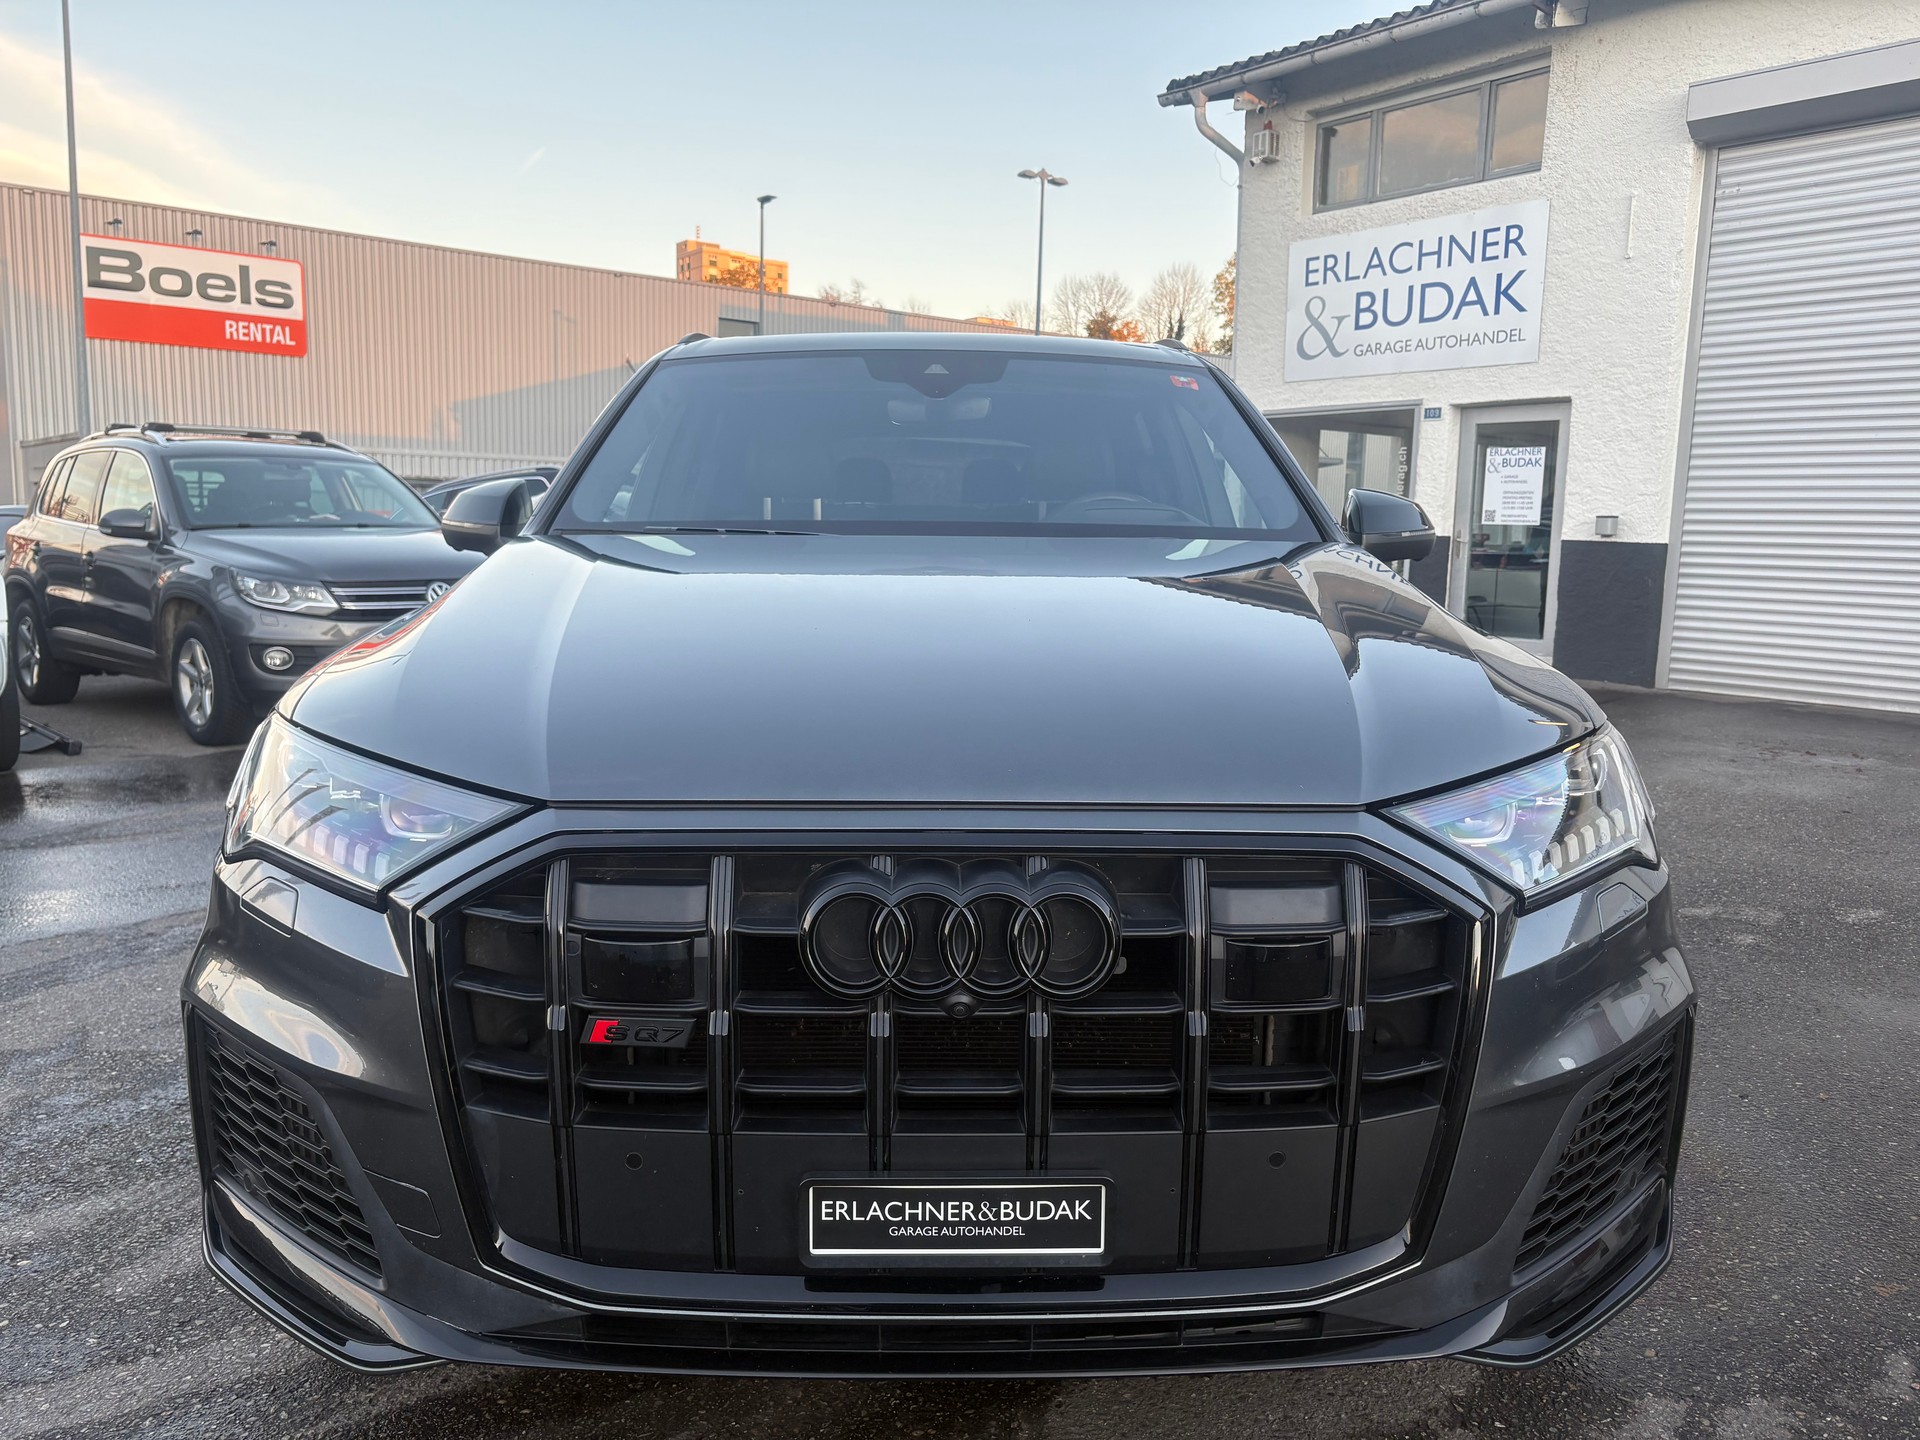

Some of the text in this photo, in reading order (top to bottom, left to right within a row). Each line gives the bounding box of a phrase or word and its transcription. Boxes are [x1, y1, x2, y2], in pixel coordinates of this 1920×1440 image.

[1304, 224, 1528, 287] ERLACHNER
[85, 245, 295, 309] Boels
[1296, 269, 1528, 360] & BUDAK
[225, 319, 296, 346] RENTAL
[1353, 328, 1526, 357] GARAGE AUTOHANDEL
[1489, 447, 1543, 457] ERLACHNER
[1501, 457, 1543, 468] BUDAK
[604, 1025, 685, 1043] SQ7
[820, 1199, 1093, 1222] ERLACHNER&BUDAK
[888, 1225, 1026, 1237] GARAGE AUTOHANDEL
